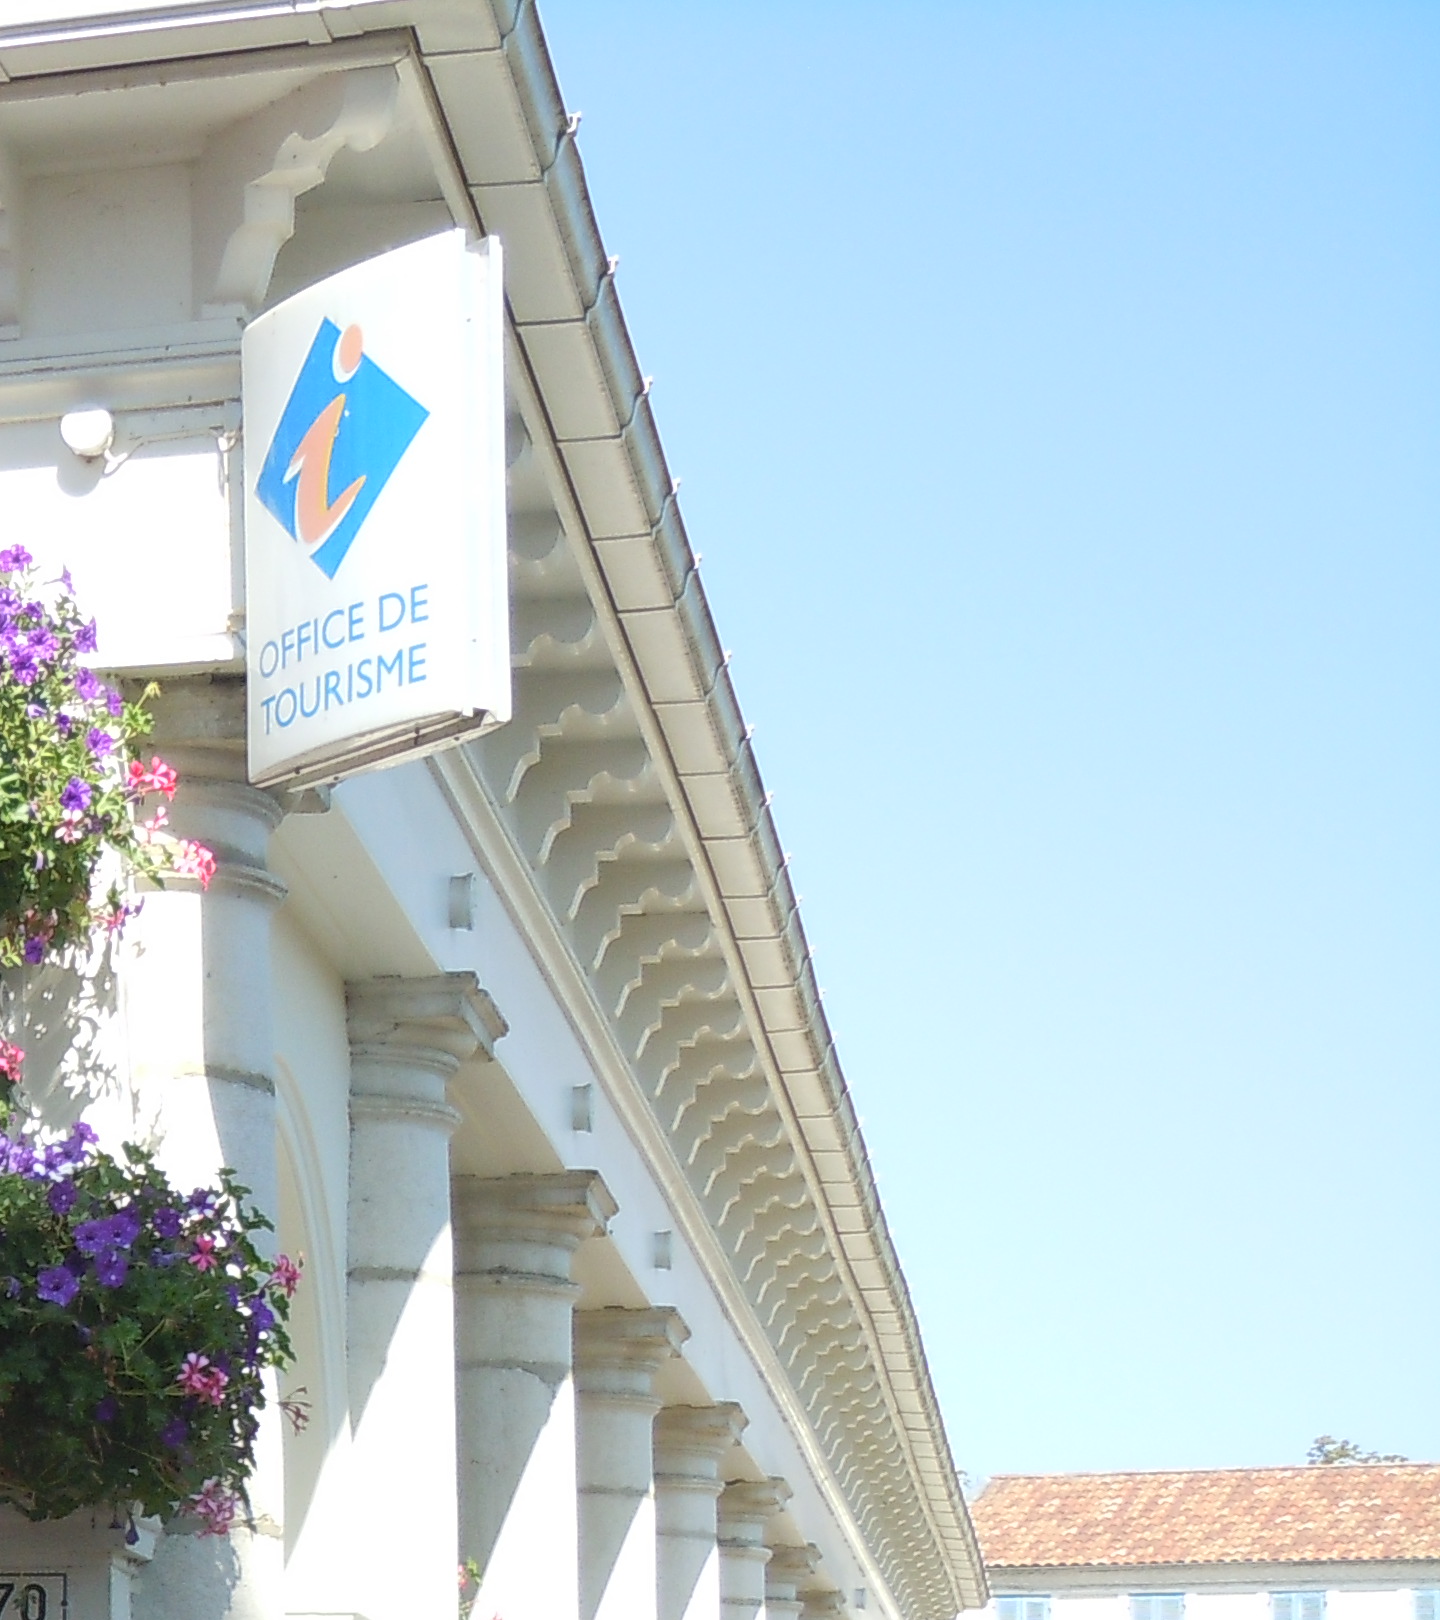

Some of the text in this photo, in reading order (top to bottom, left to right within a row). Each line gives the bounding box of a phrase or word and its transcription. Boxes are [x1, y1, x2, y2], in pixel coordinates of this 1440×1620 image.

[258, 584, 429, 680] OFFICE DE
[260, 643, 428, 735] TOURISME
